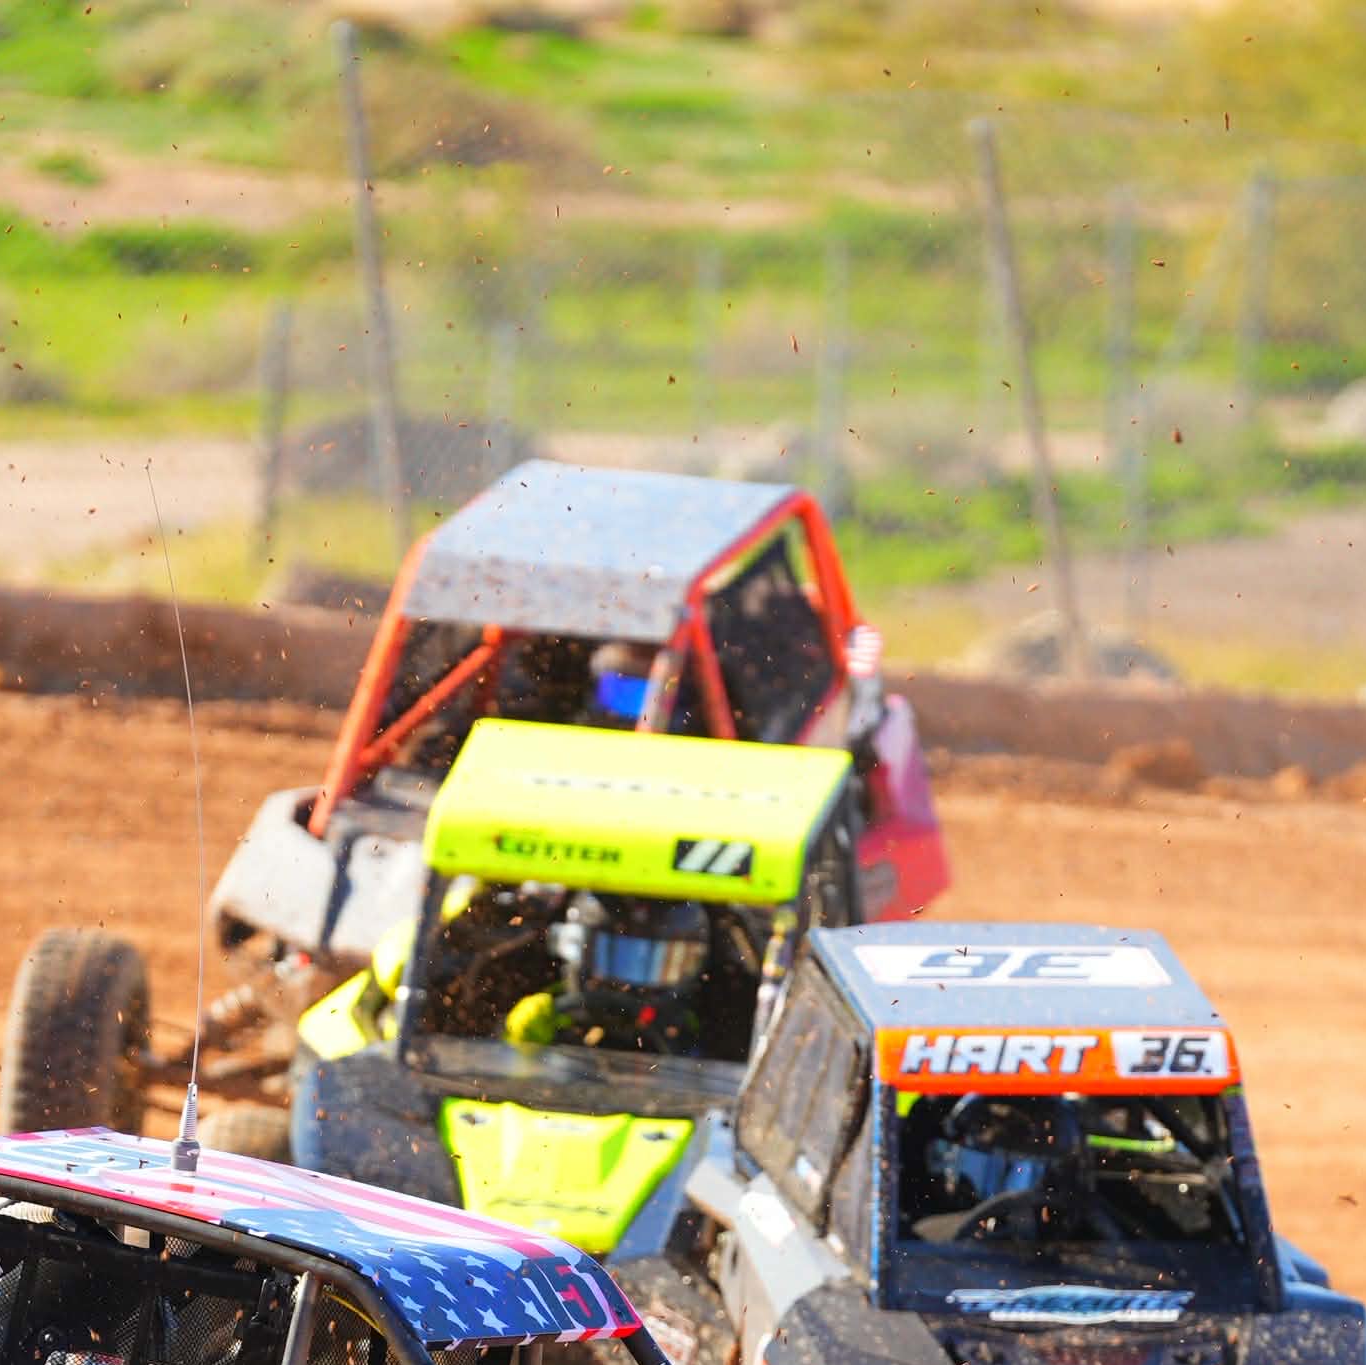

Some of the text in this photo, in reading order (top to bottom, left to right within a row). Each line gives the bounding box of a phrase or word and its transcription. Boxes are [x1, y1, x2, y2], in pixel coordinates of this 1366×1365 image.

[495, 835, 622, 863] COTTER
[901, 1034, 1210, 1074] HART 36
[522, 1256, 637, 1330] 151
